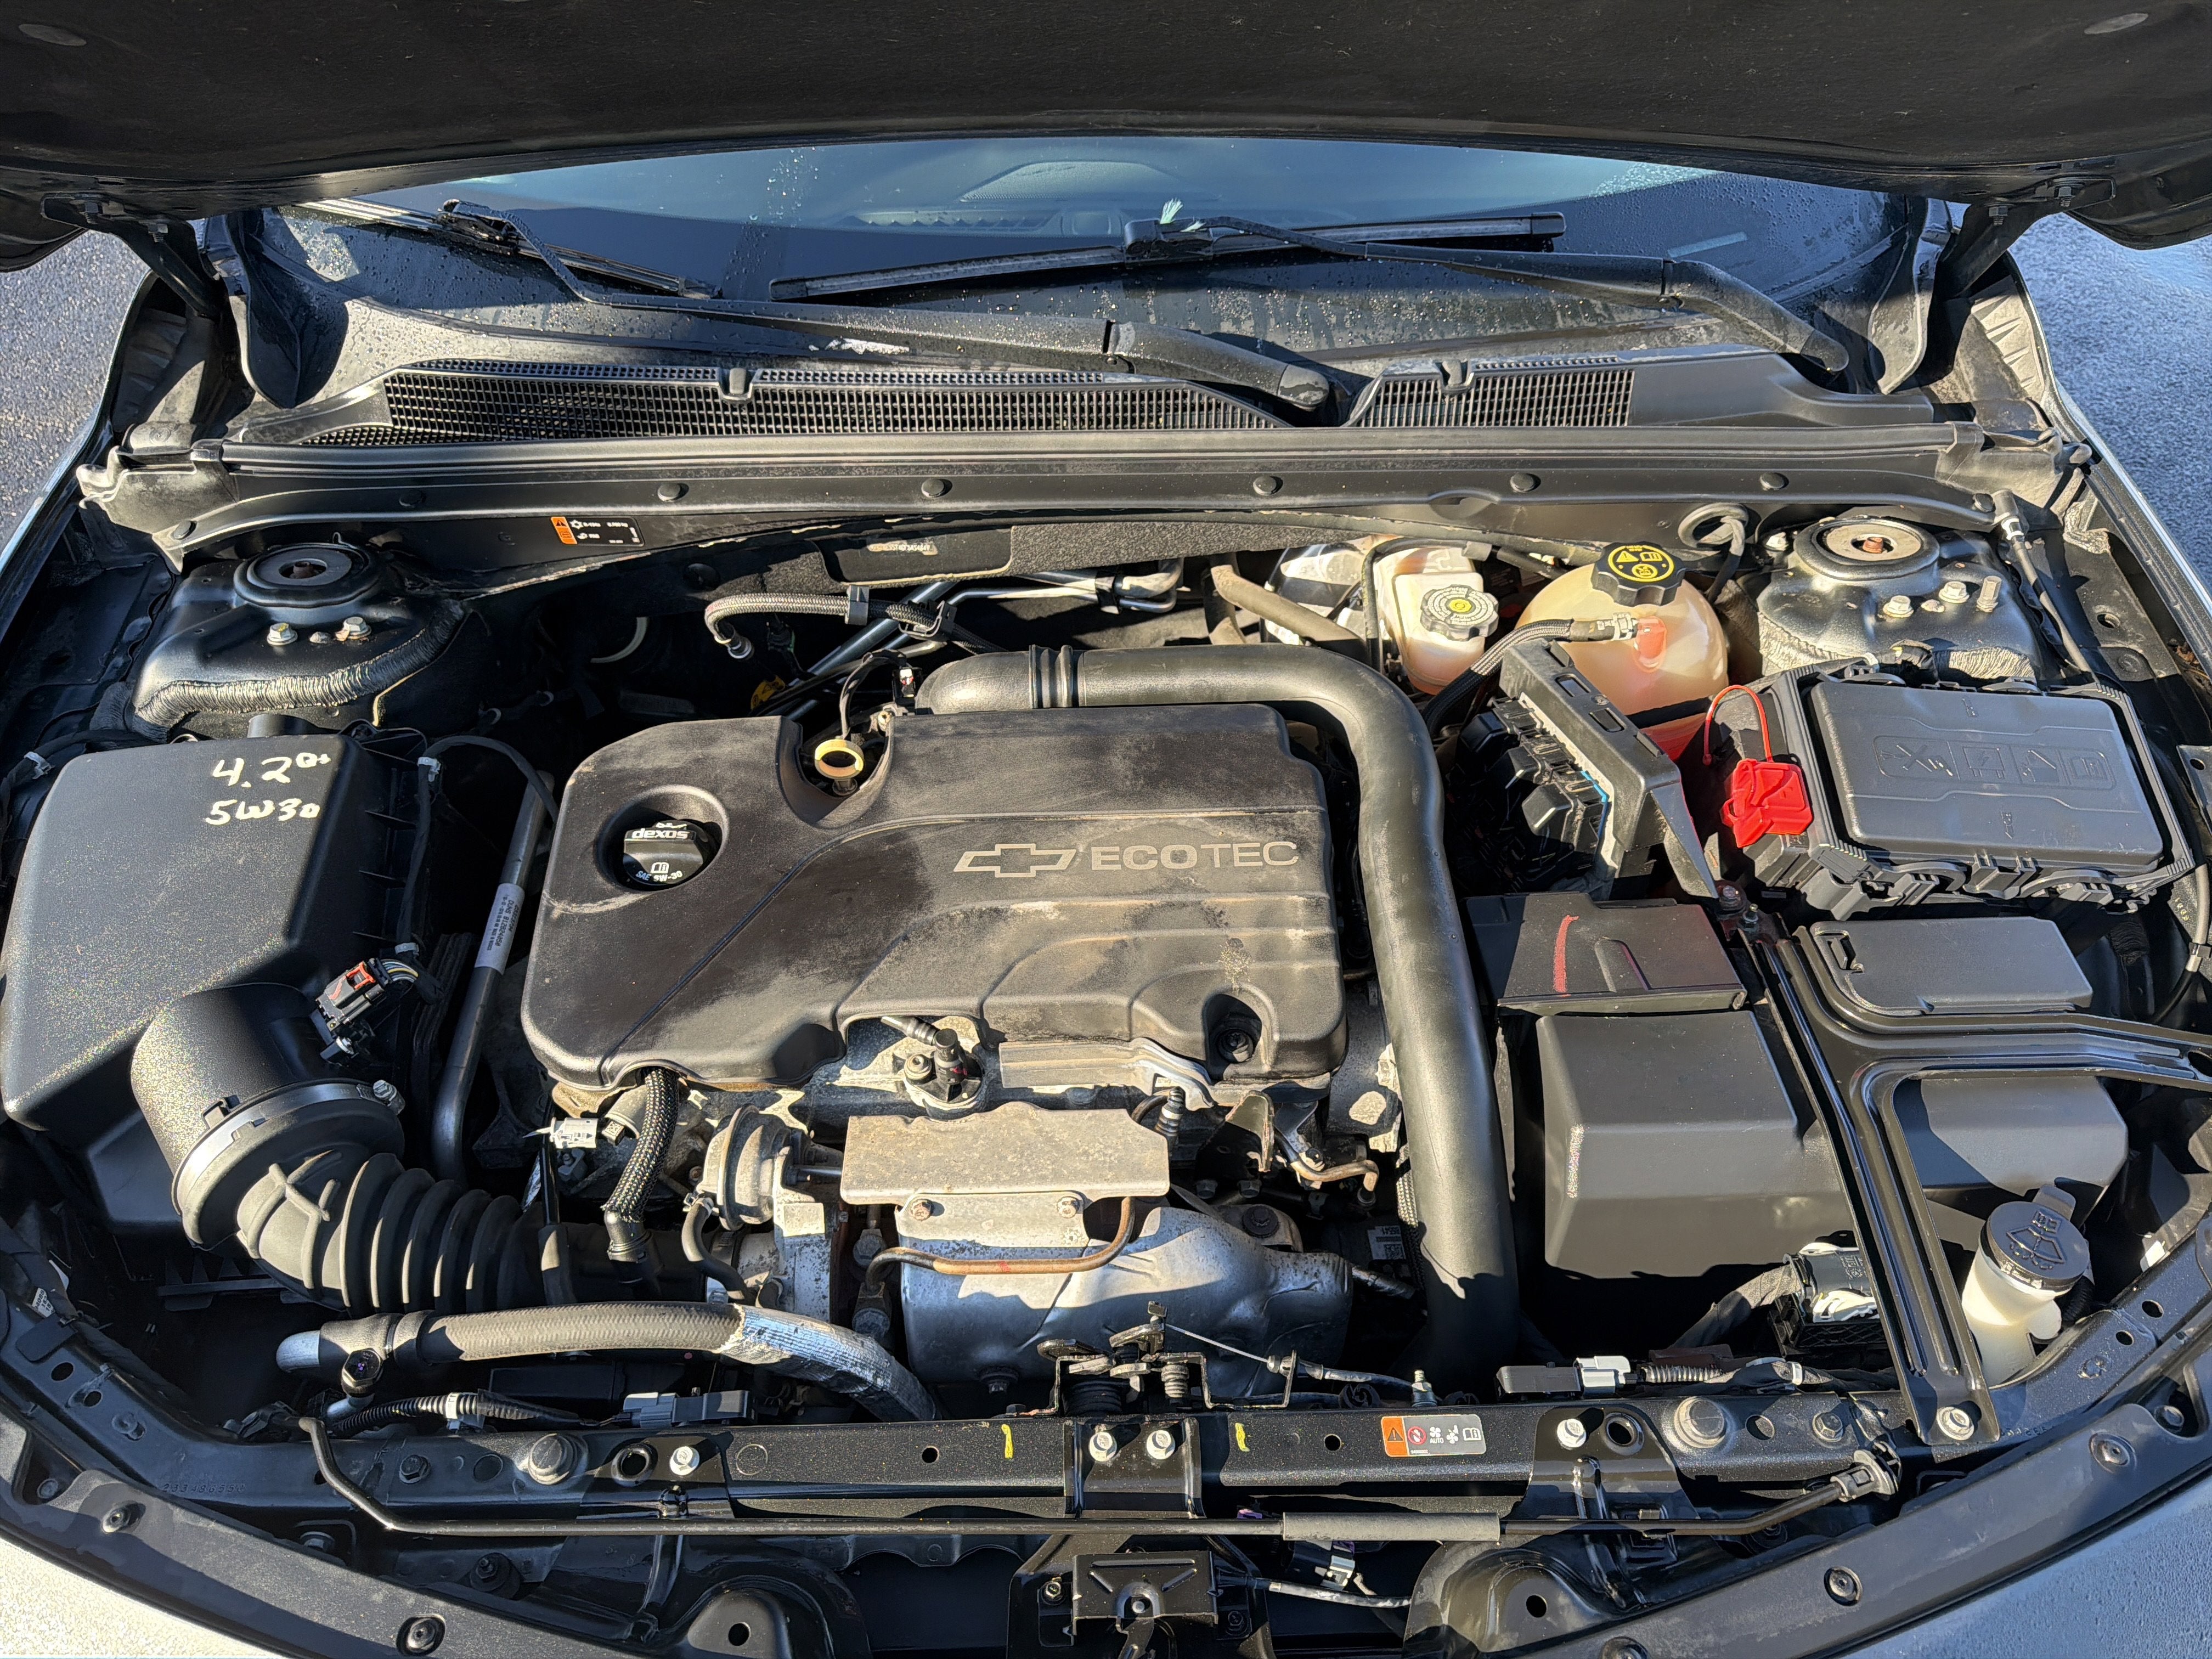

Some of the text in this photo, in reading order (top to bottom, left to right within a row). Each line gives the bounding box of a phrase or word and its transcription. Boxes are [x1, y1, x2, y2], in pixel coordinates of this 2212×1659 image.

[632, 828, 690, 839] dexos
[1091, 841, 1299, 871] ECOTEC
[635, 870, 683, 882] SAE 5W-30
